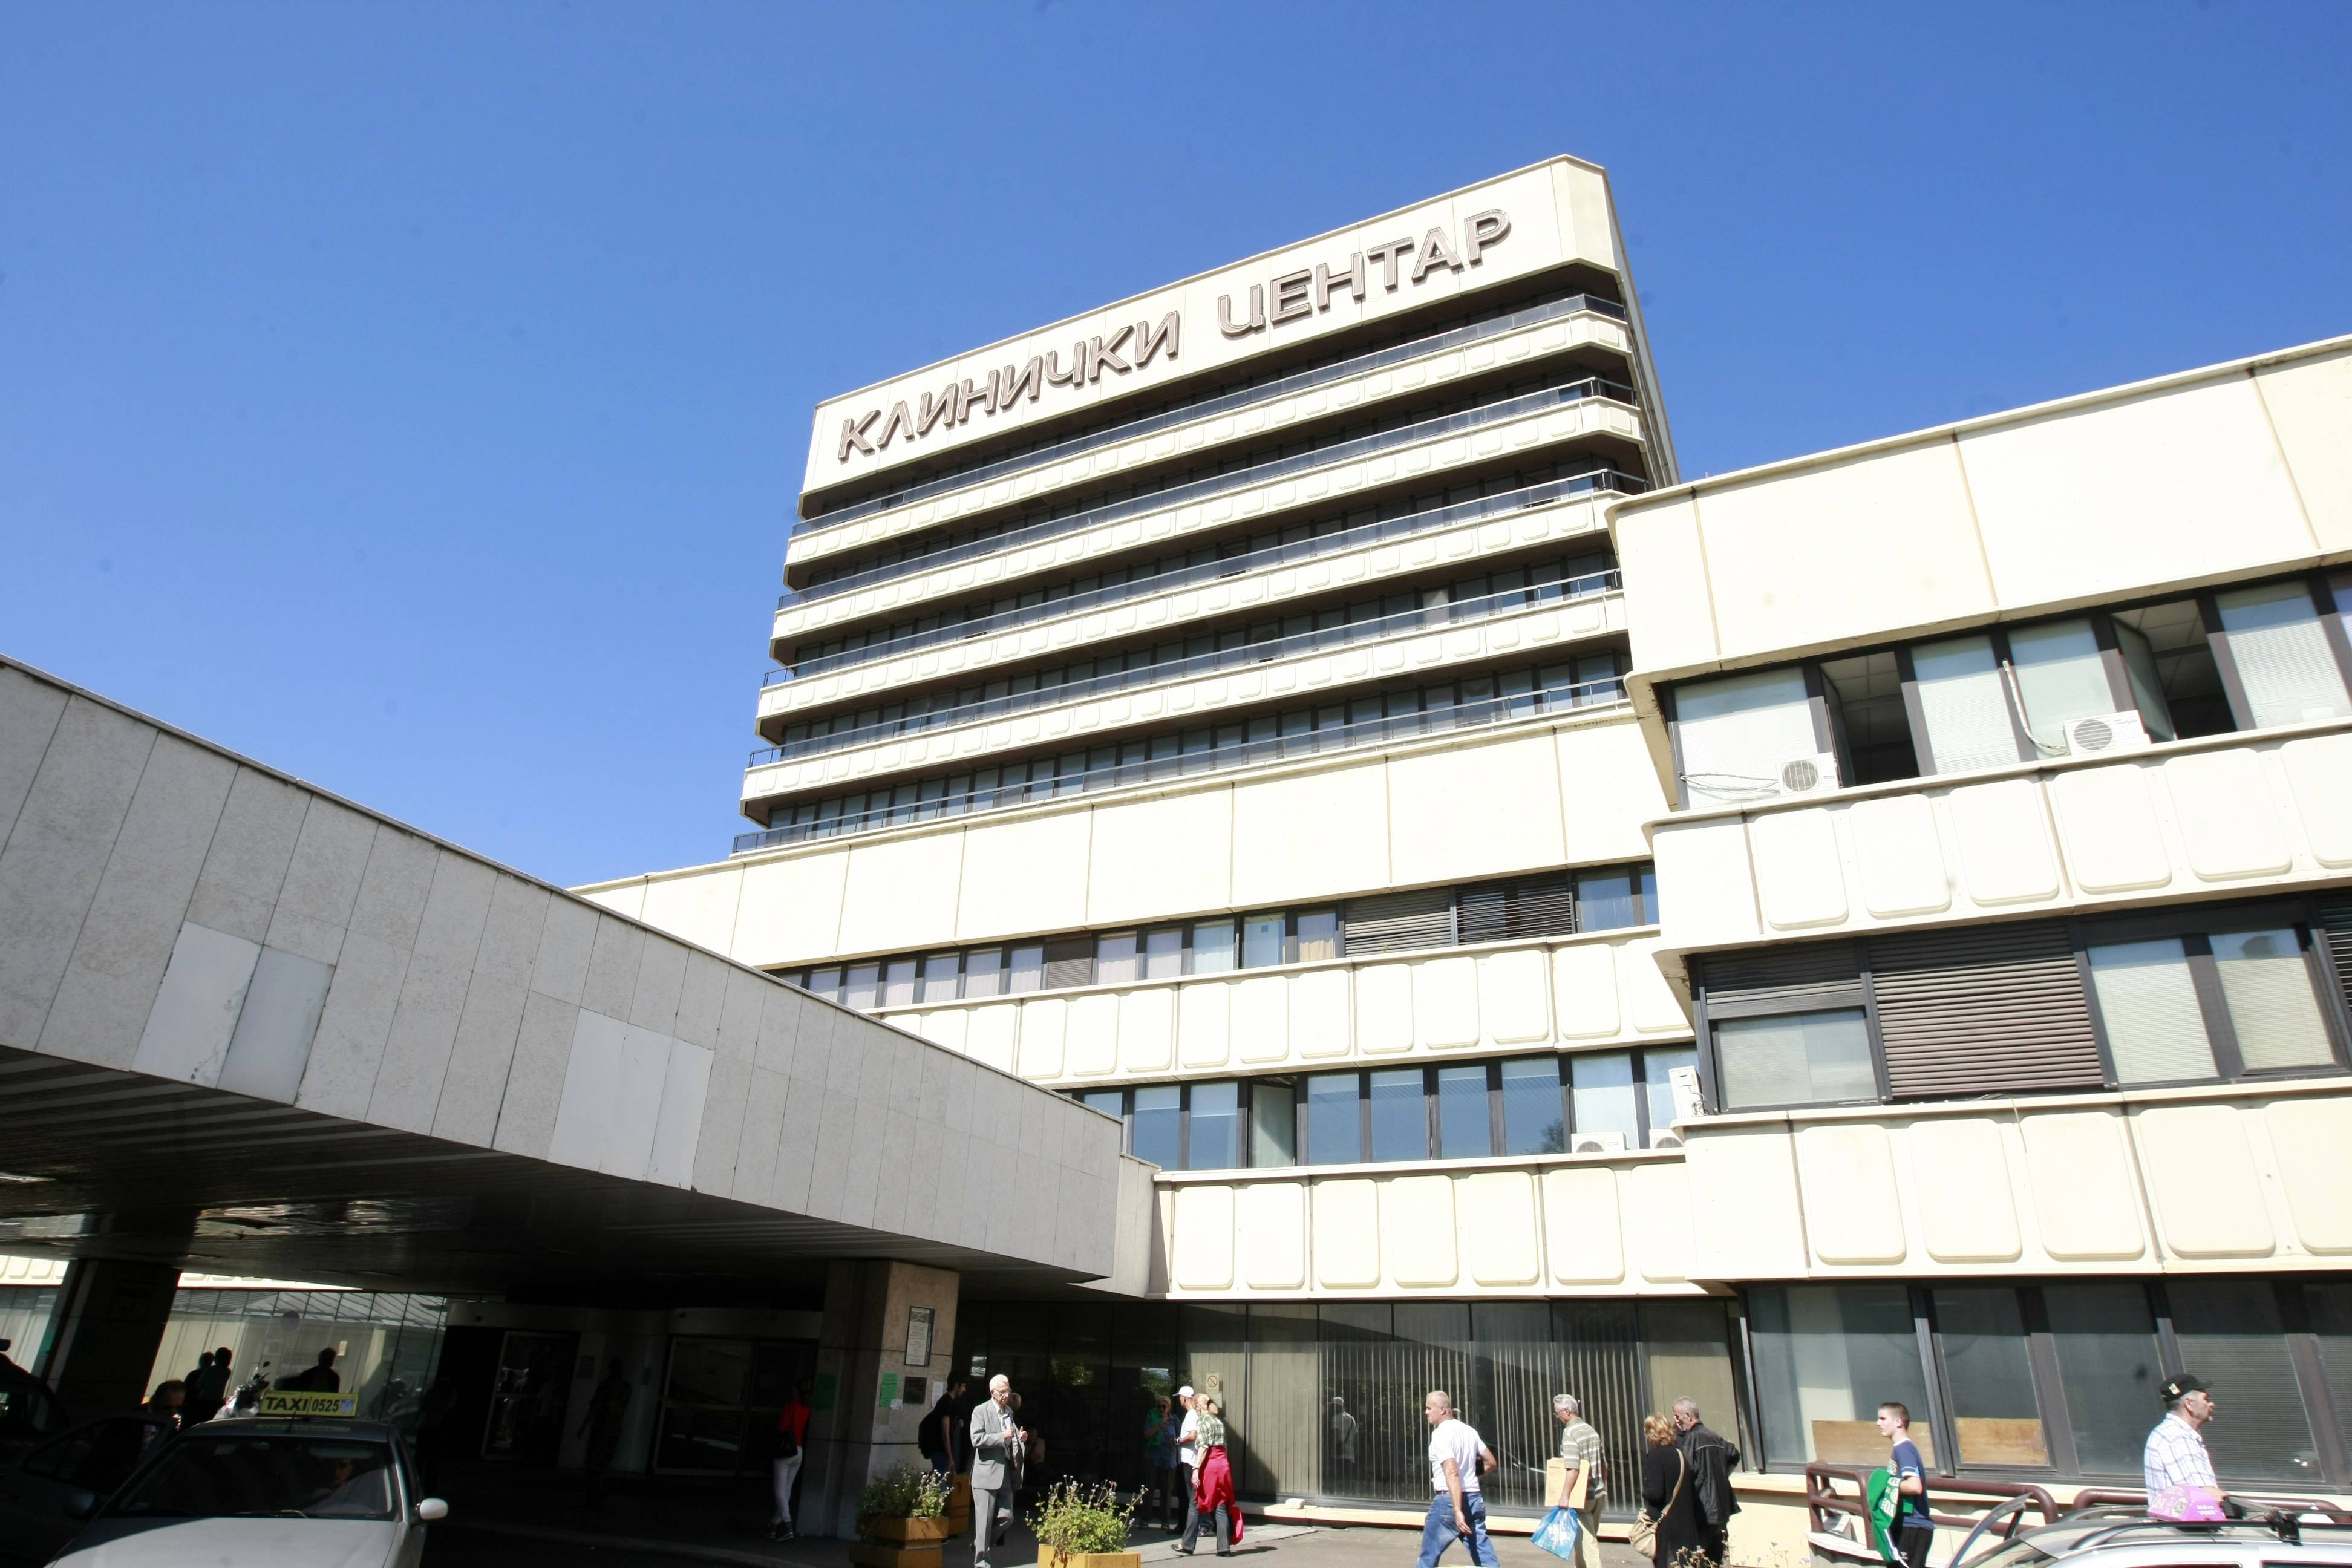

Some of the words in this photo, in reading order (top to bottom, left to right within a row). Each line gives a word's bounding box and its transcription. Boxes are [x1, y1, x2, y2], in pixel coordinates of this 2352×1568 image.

[838, 310, 1180, 462] КЛИНИЧКИ
[1218, 209, 1512, 337] ЦЕНТАР
[265, 1397, 309, 1411] TAXI
[312, 1399, 340, 1413] 0525
